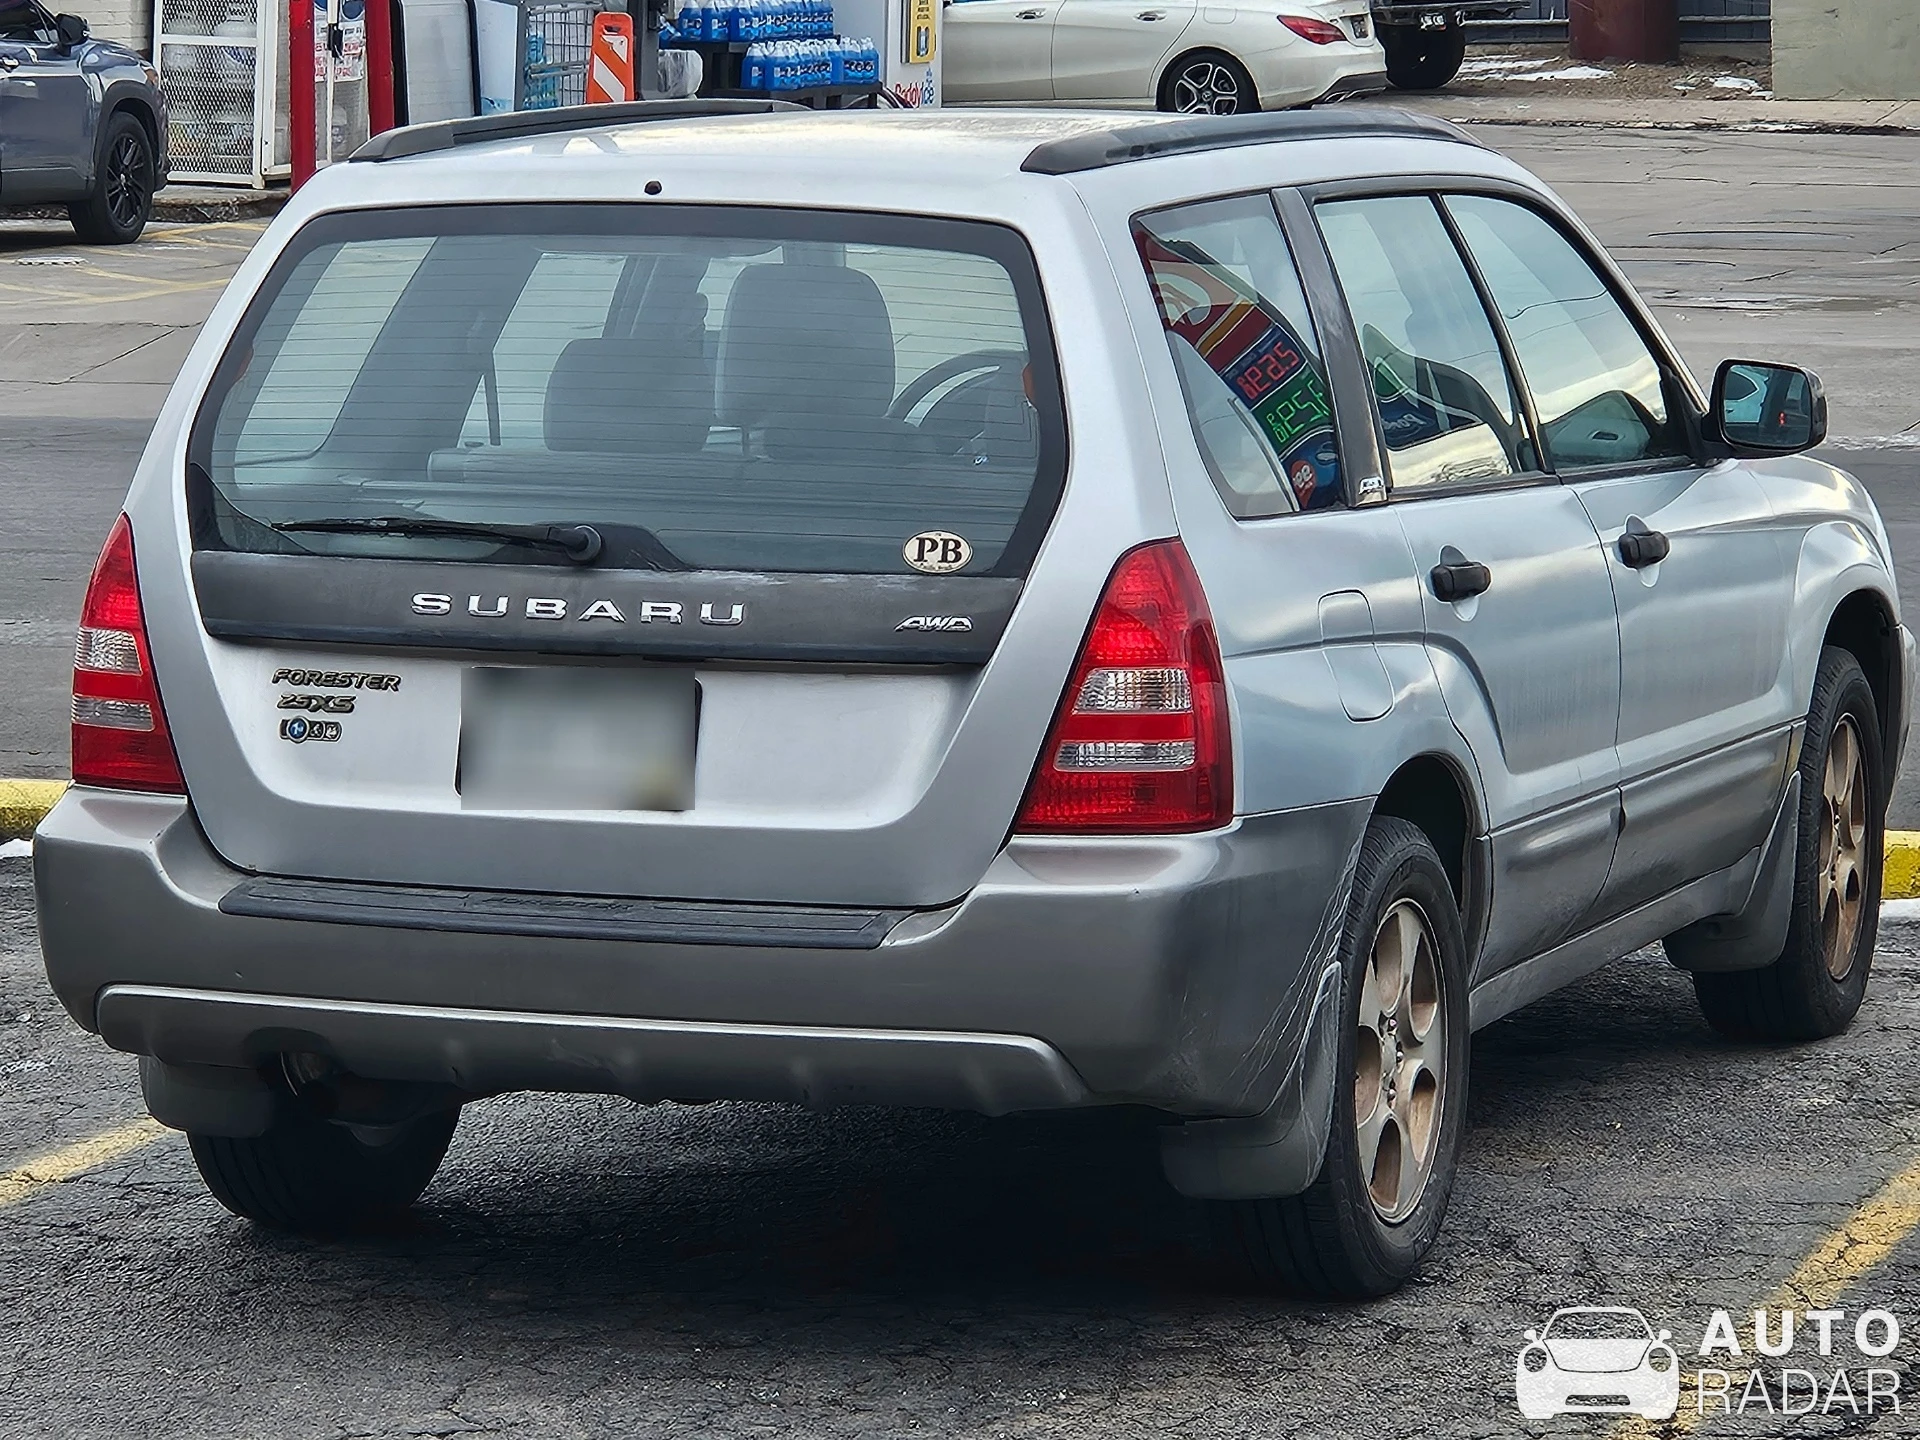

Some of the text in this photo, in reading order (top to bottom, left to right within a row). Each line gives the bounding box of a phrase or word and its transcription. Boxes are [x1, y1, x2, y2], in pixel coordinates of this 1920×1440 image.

[913, 536, 963, 564] PB
[411, 592, 745, 626] SUBARU
[893, 615, 974, 632] AWD
[271, 668, 402, 692] FORESTER
